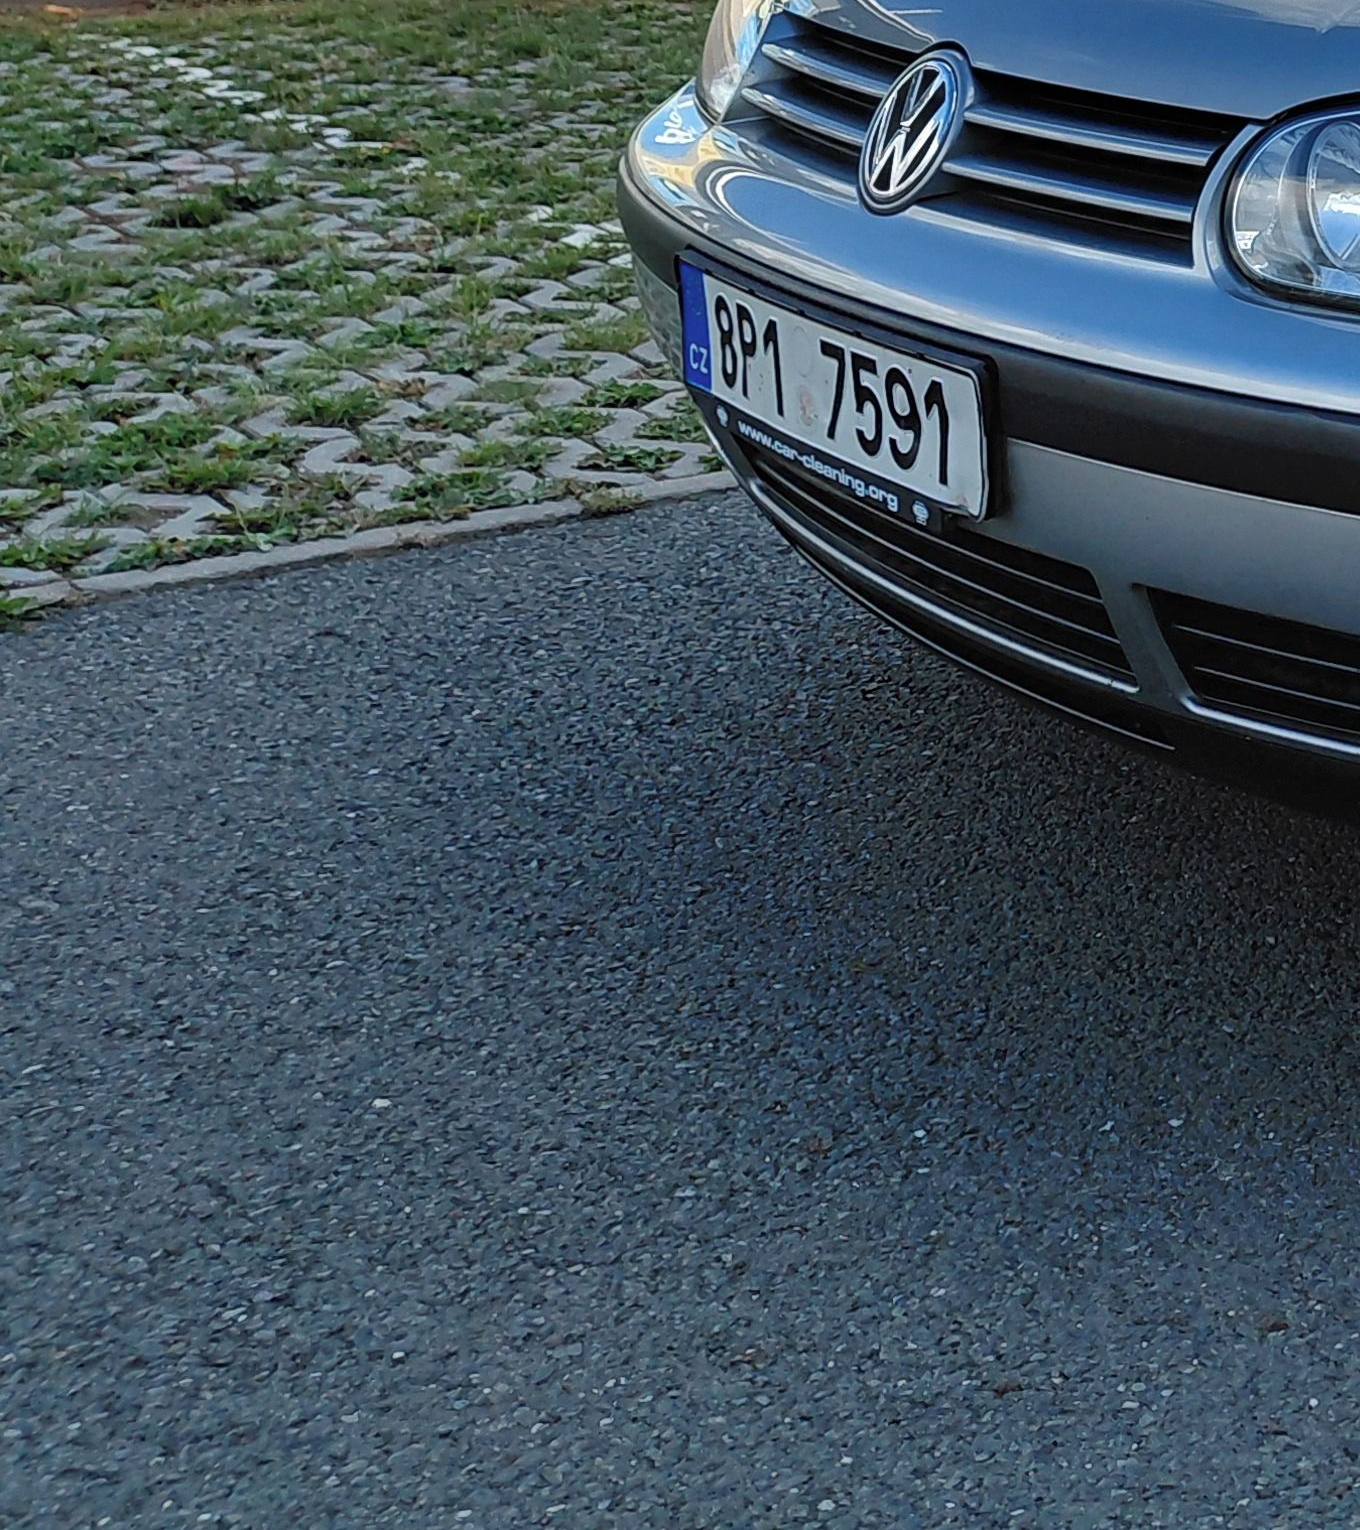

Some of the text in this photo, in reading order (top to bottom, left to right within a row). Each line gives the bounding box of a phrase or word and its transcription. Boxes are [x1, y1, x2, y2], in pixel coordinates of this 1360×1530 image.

[689, 343, 708, 375] CZ
[714, 293, 949, 488] 8P1 7591
[738, 419, 898, 512] www.car-cleaning.org
